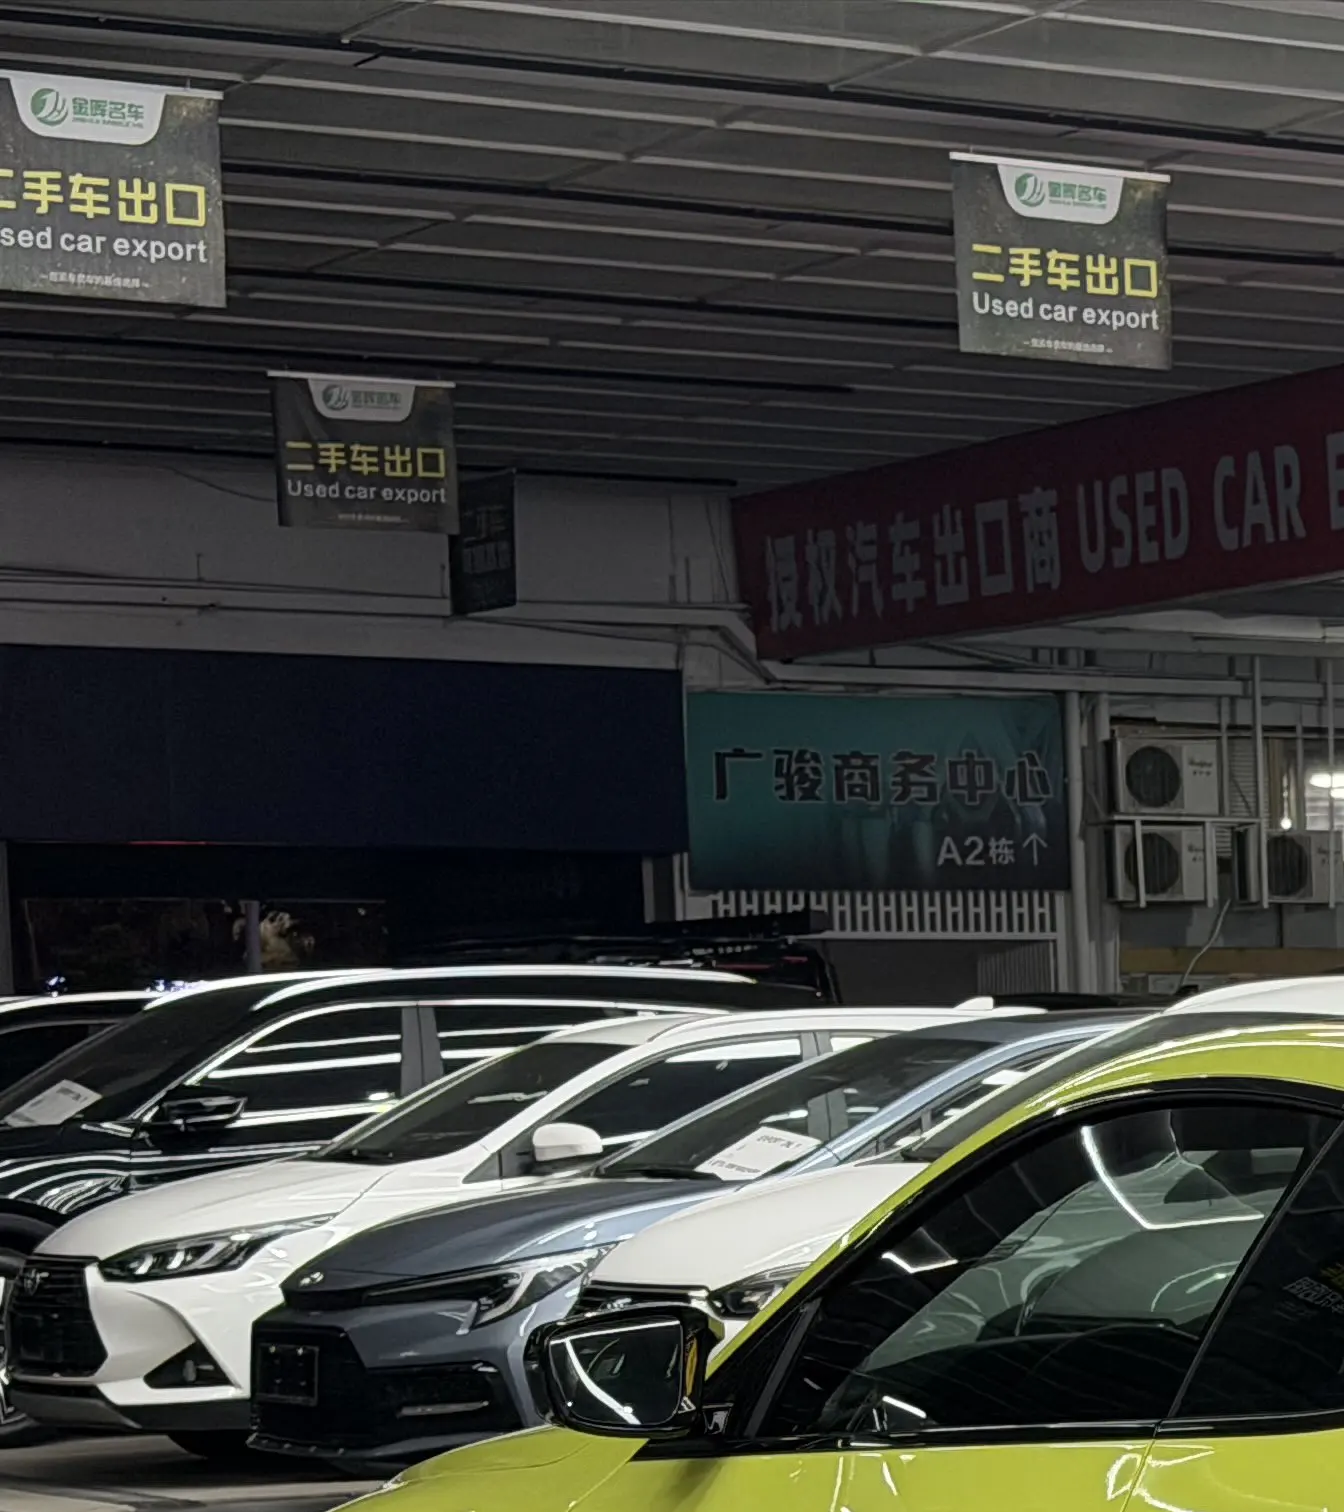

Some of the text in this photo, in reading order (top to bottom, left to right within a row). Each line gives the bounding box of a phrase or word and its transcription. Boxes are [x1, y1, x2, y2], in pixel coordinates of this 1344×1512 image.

[0, 226, 208, 263] sed car export
[971, 243, 1158, 299] 二手车出口
[972, 291, 1160, 331] Used car export
[285, 440, 447, 479] 二手车出口
[286, 479, 447, 504] Used car export
[1077, 467, 1189, 574] USED
[1213, 444, 1307, 552] CAR
[713, 747, 1053, 807] 广骏商务中心
